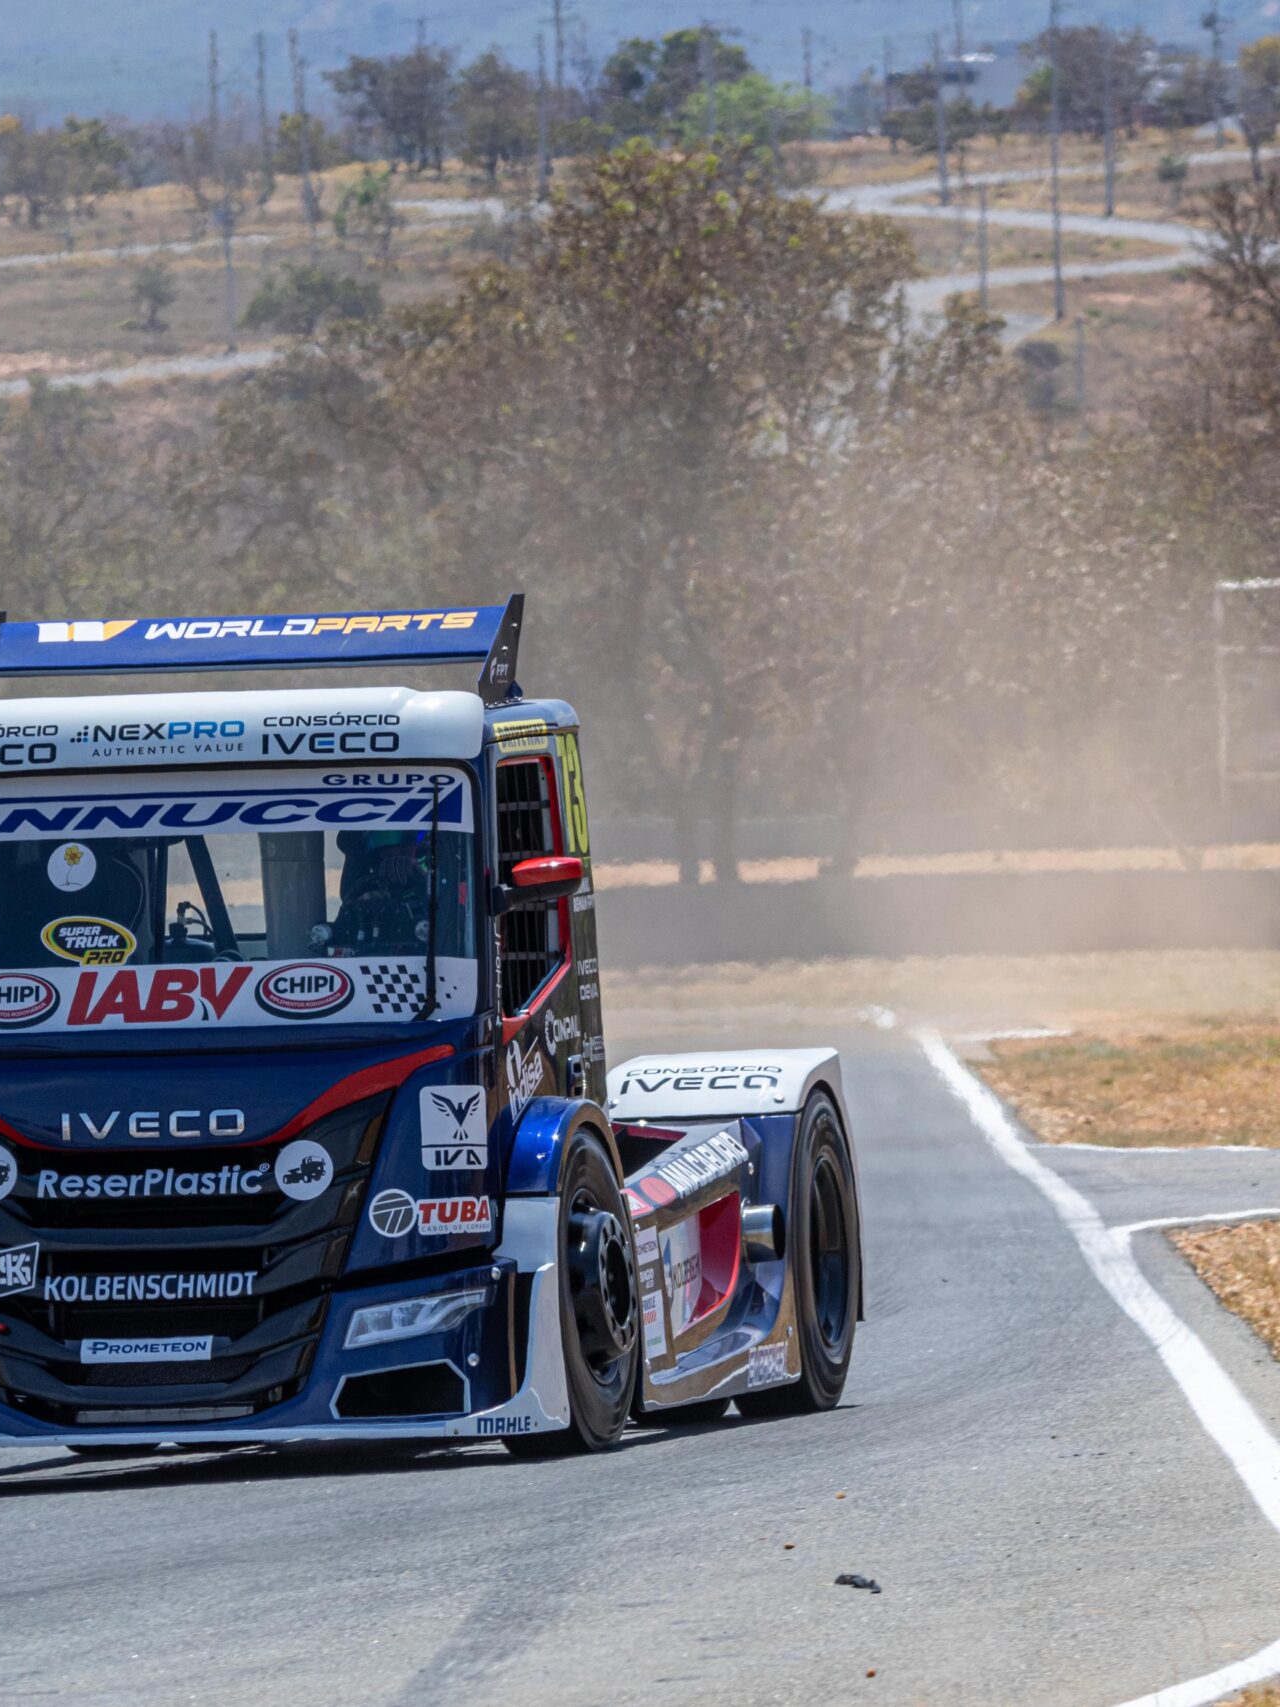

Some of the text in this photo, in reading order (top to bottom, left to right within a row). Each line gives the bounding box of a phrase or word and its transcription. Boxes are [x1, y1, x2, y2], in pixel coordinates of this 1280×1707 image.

[144, 611, 479, 640] WORLDPARTS
[263, 712, 401, 727] CONSÓRCIO
[92, 720, 245, 743] NEXPRO
[92, 743, 245, 757] AUTHENTIC VALUE
[262, 732, 400, 755] IVECO
[322, 774, 456, 786] GRUPO
[554, 733, 589, 854] 73
[58, 925, 102, 938] SUPER
[64, 934, 120, 949] TRUCK
[85, 951, 126, 965] PRO
[577, 957, 597, 977] IVECO
[273, 974, 335, 995] CHIPI
[552, 1014, 581, 1043] CINPAL
[626, 1065, 783, 1078] CONSÓRCIO
[620, 1074, 779, 1095] IVECO
[61, 1108, 246, 1141] IVECO
[435, 1149, 482, 1166] IVA
[419, 1199, 490, 1224] TUBA
[44, 1271, 258, 1302] KOLBENSCHMIDT
[86, 1341, 207, 1355] PROMETEON
[476, 1415, 532, 1434] MAHLE
